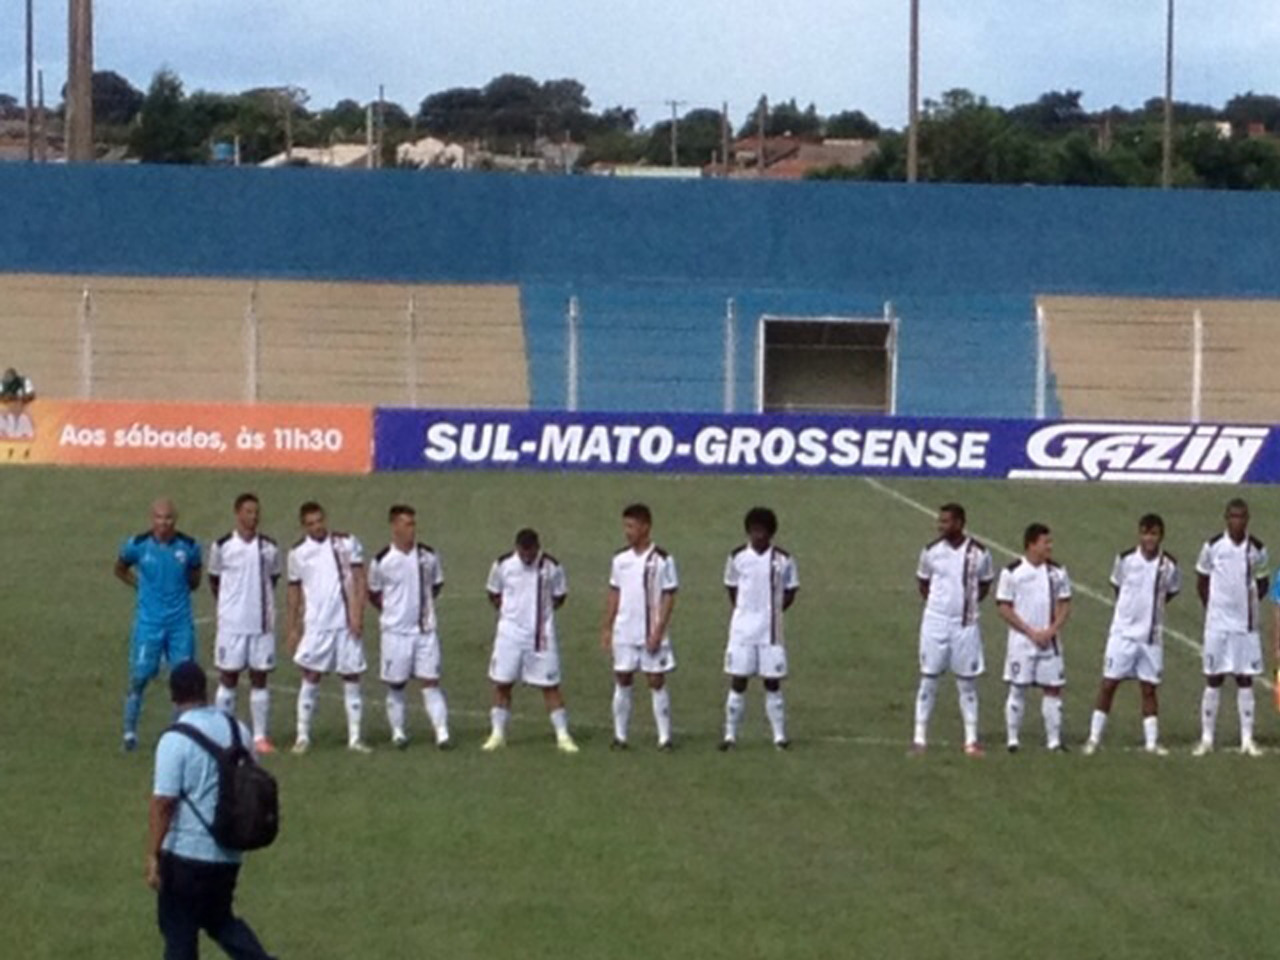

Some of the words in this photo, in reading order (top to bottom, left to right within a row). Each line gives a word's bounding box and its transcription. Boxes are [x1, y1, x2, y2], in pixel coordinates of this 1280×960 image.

[60, 424, 106, 446] Aos
[114, 422, 227, 452] sábados,
[236, 426, 265, 449] às
[274, 428, 343, 451] 11h30
[424, 422, 992, 469] SUL-MATO-GROSSENSE
